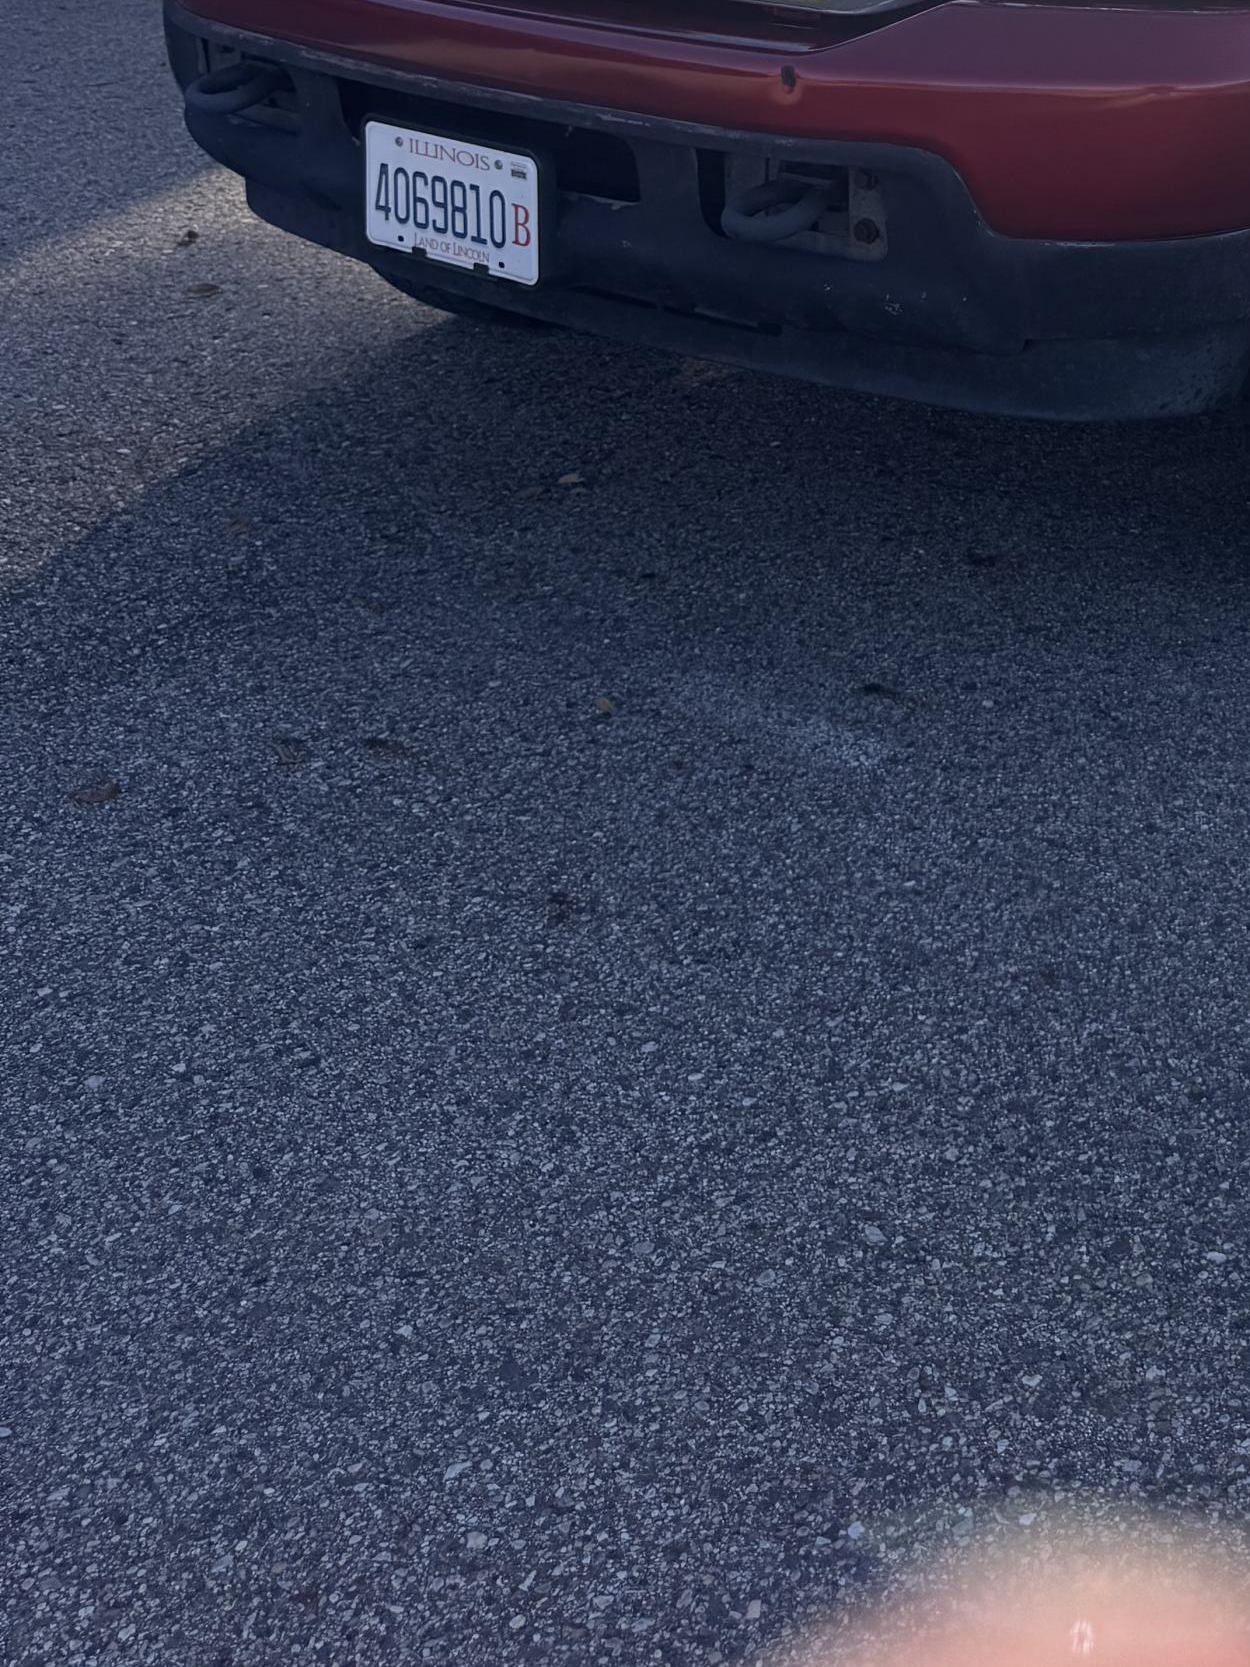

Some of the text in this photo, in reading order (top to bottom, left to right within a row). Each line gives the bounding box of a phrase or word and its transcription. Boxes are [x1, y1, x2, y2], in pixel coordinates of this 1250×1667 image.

[409, 138, 490, 171] ILLINOIS
[375, 163, 531, 248] 4069810 B
